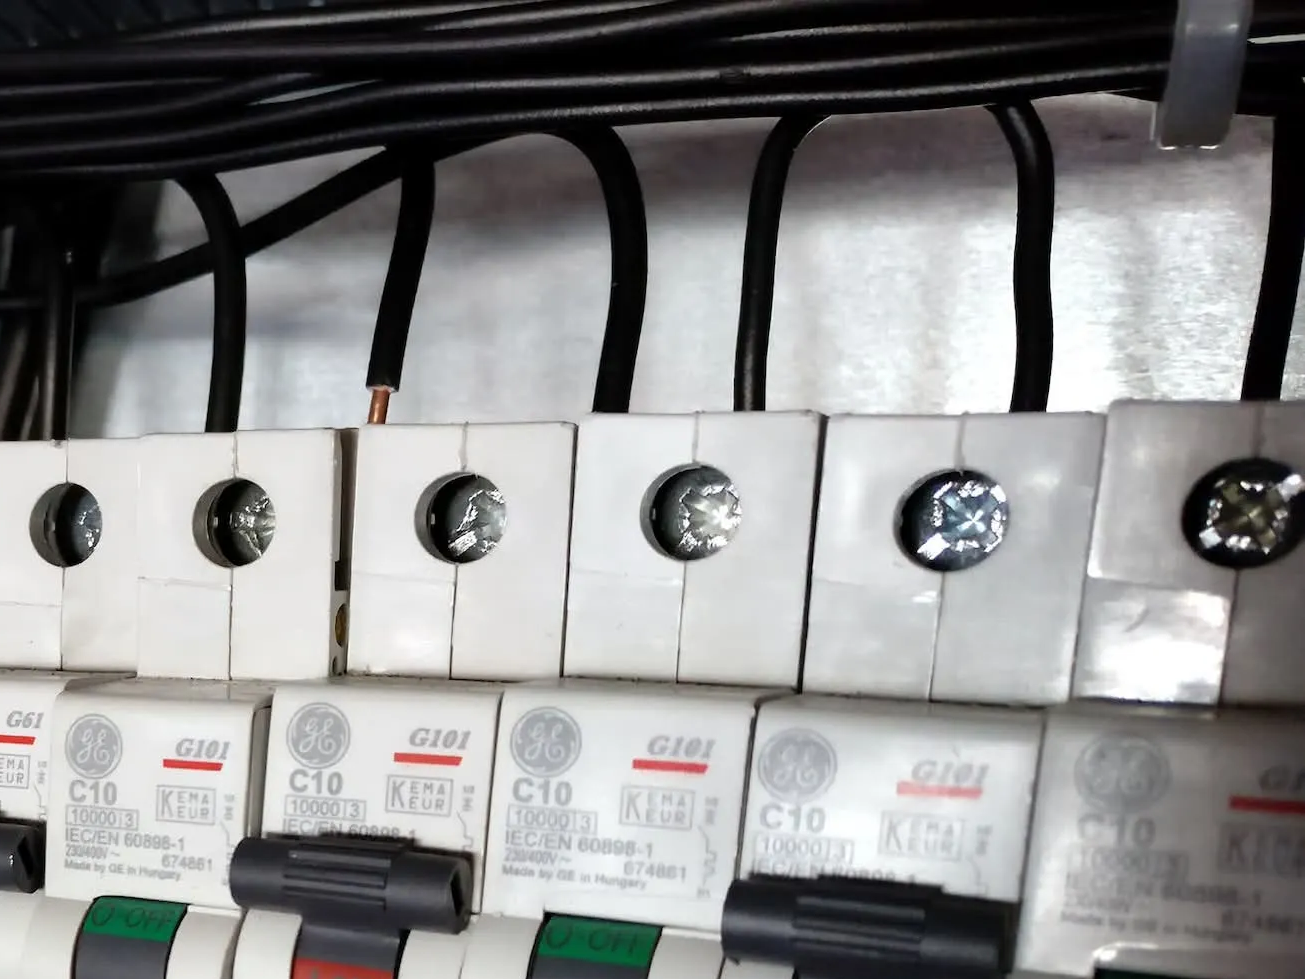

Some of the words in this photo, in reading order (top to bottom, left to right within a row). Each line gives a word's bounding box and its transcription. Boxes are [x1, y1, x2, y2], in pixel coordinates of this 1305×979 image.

[6, 710, 44, 729] G61
[175, 738, 230, 760] G101
[409, 728, 471, 750] G101
[647, 735, 716, 760] G101
[69, 780, 118, 805] C10
[289, 769, 343, 796] C10
[512, 777, 572, 807] C10
[71, 807, 117, 826] 10000
[291, 799, 340, 817] 10000
[349, 804, 359, 819] 3
[515, 808, 570, 830] 10000
[580, 814, 591, 831] 3
[759, 803, 826, 834] C10
[65, 827, 119, 847] IEC/EN
[505, 830, 573, 851] IEC/EN
